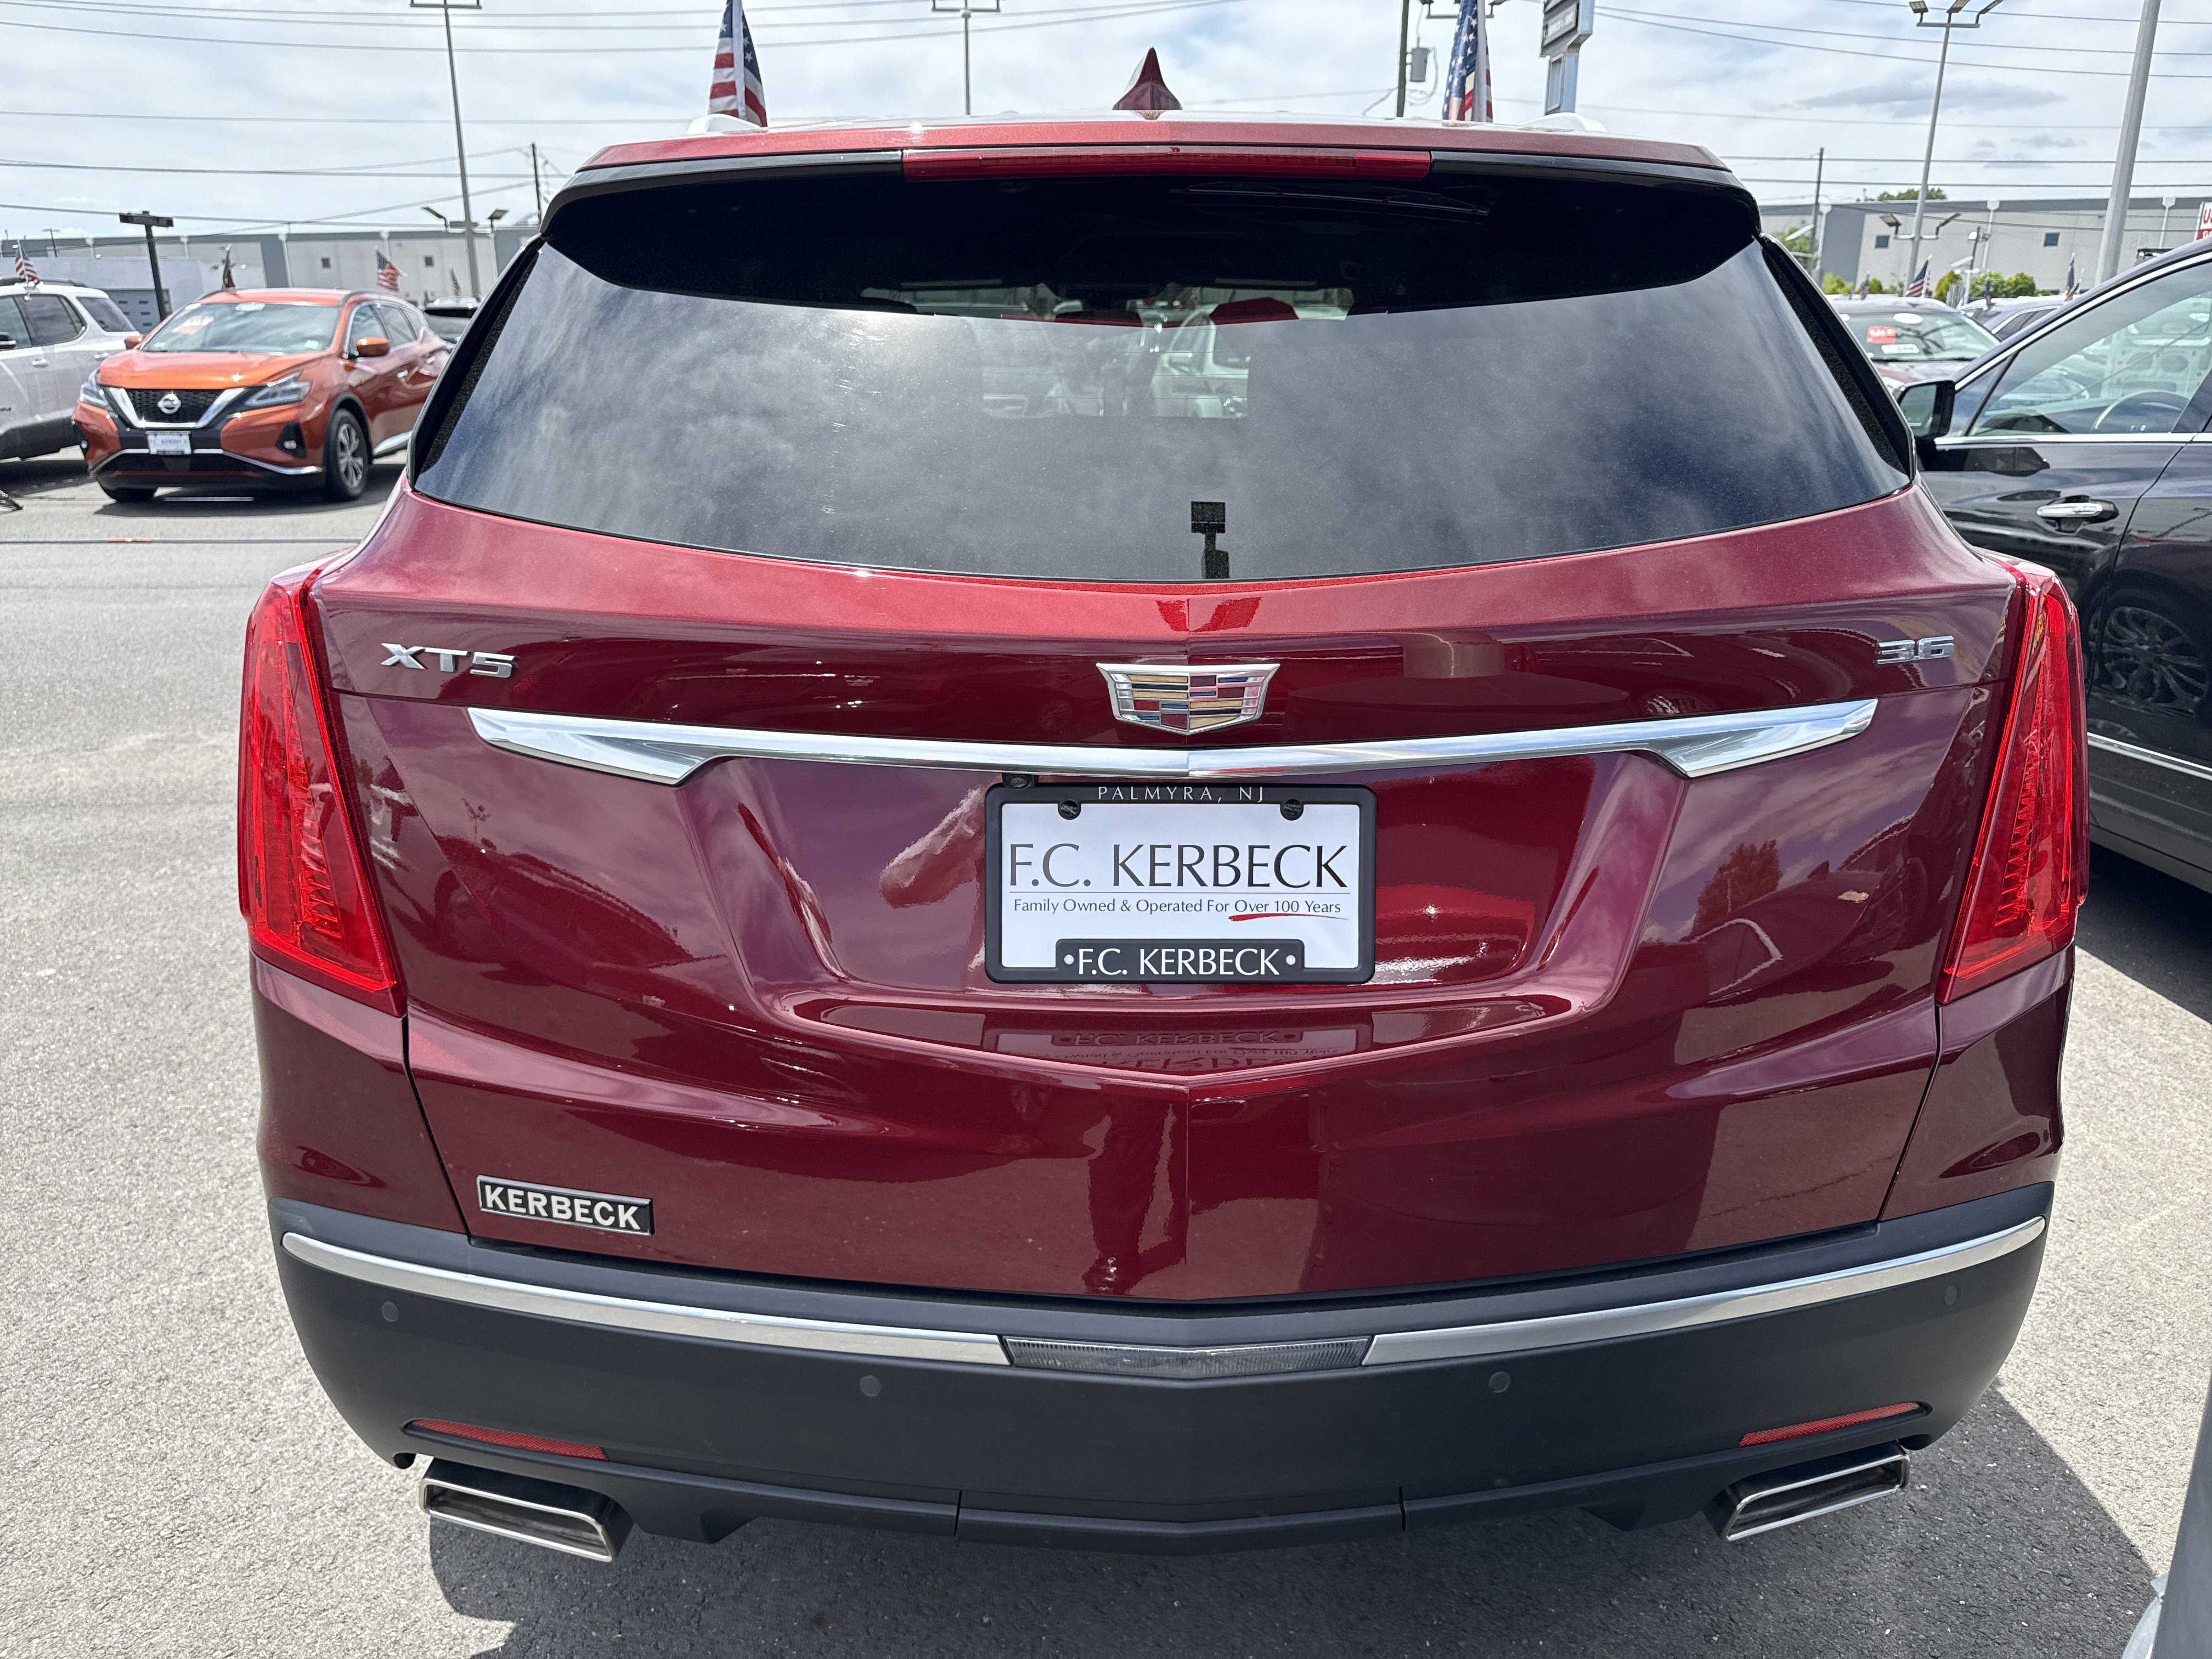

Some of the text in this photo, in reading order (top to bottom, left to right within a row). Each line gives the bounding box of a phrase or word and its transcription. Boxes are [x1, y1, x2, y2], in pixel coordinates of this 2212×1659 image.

[380, 642, 515, 678] XT5
[1098, 786, 1263, 803] PALMYRA, NJ
[1010, 843, 1348, 888] F.C. KERBECK
[1014, 898, 1341, 915] Family Owned & Operated For Over 100 Years
[1078, 948, 1280, 975] F.C. KERBECK
[485, 1184, 641, 1230] KERBECK
